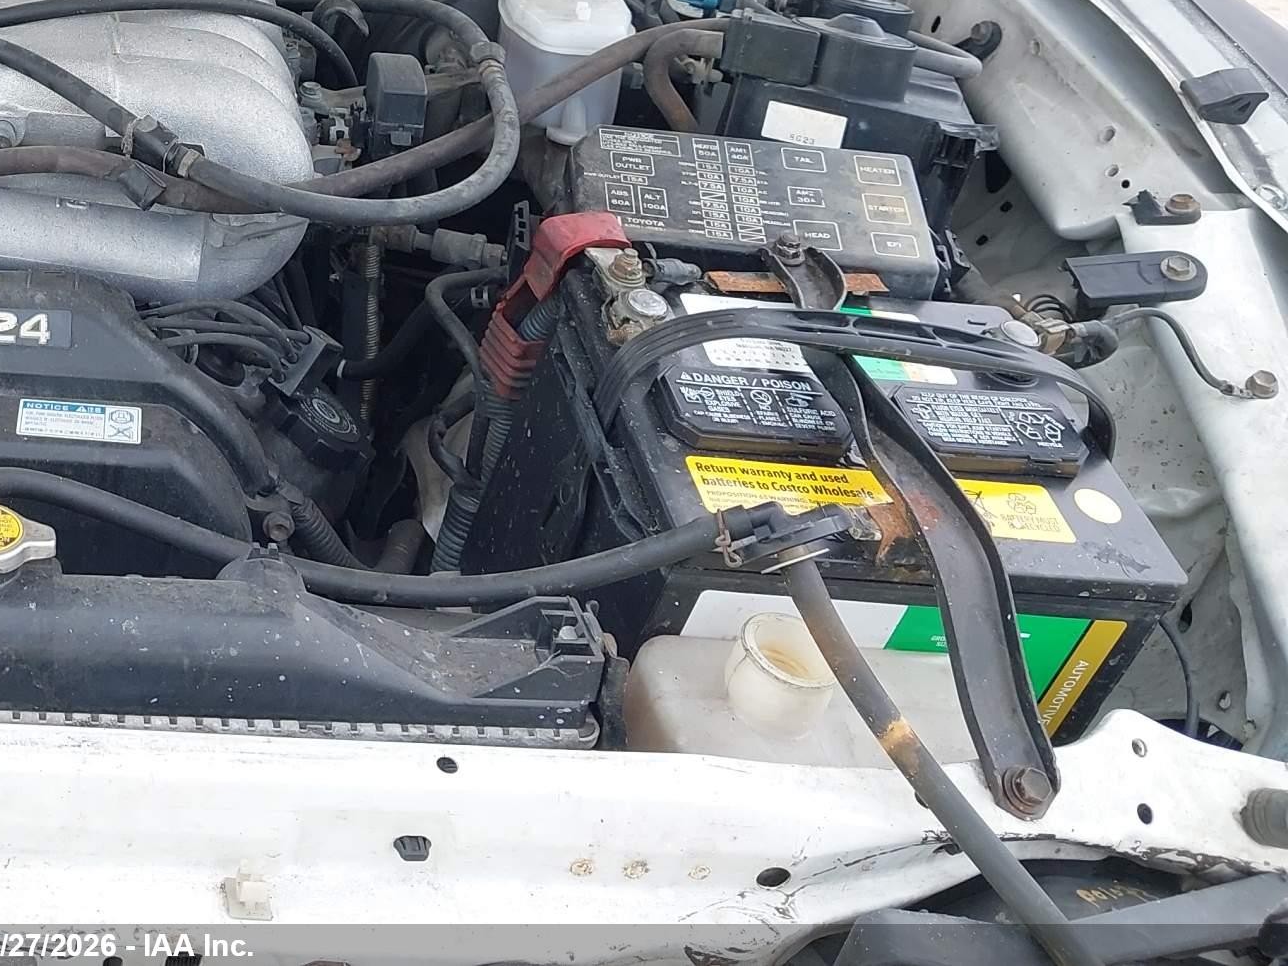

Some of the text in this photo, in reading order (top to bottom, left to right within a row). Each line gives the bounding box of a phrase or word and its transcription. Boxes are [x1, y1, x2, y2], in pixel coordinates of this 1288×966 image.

[615, 162, 651, 171] OUTLET
[644, 193, 662, 201] ALT
[626, 217, 665, 227] TOYOTA
[692, 372, 750, 386] DANGER
[761, 378, 812, 391] POISON
[26, 402, 69, 411] NOTICE
[695, 461, 849, 484] Return warranty and used
[701, 475, 874, 500] batteries to Costco Wholesale
